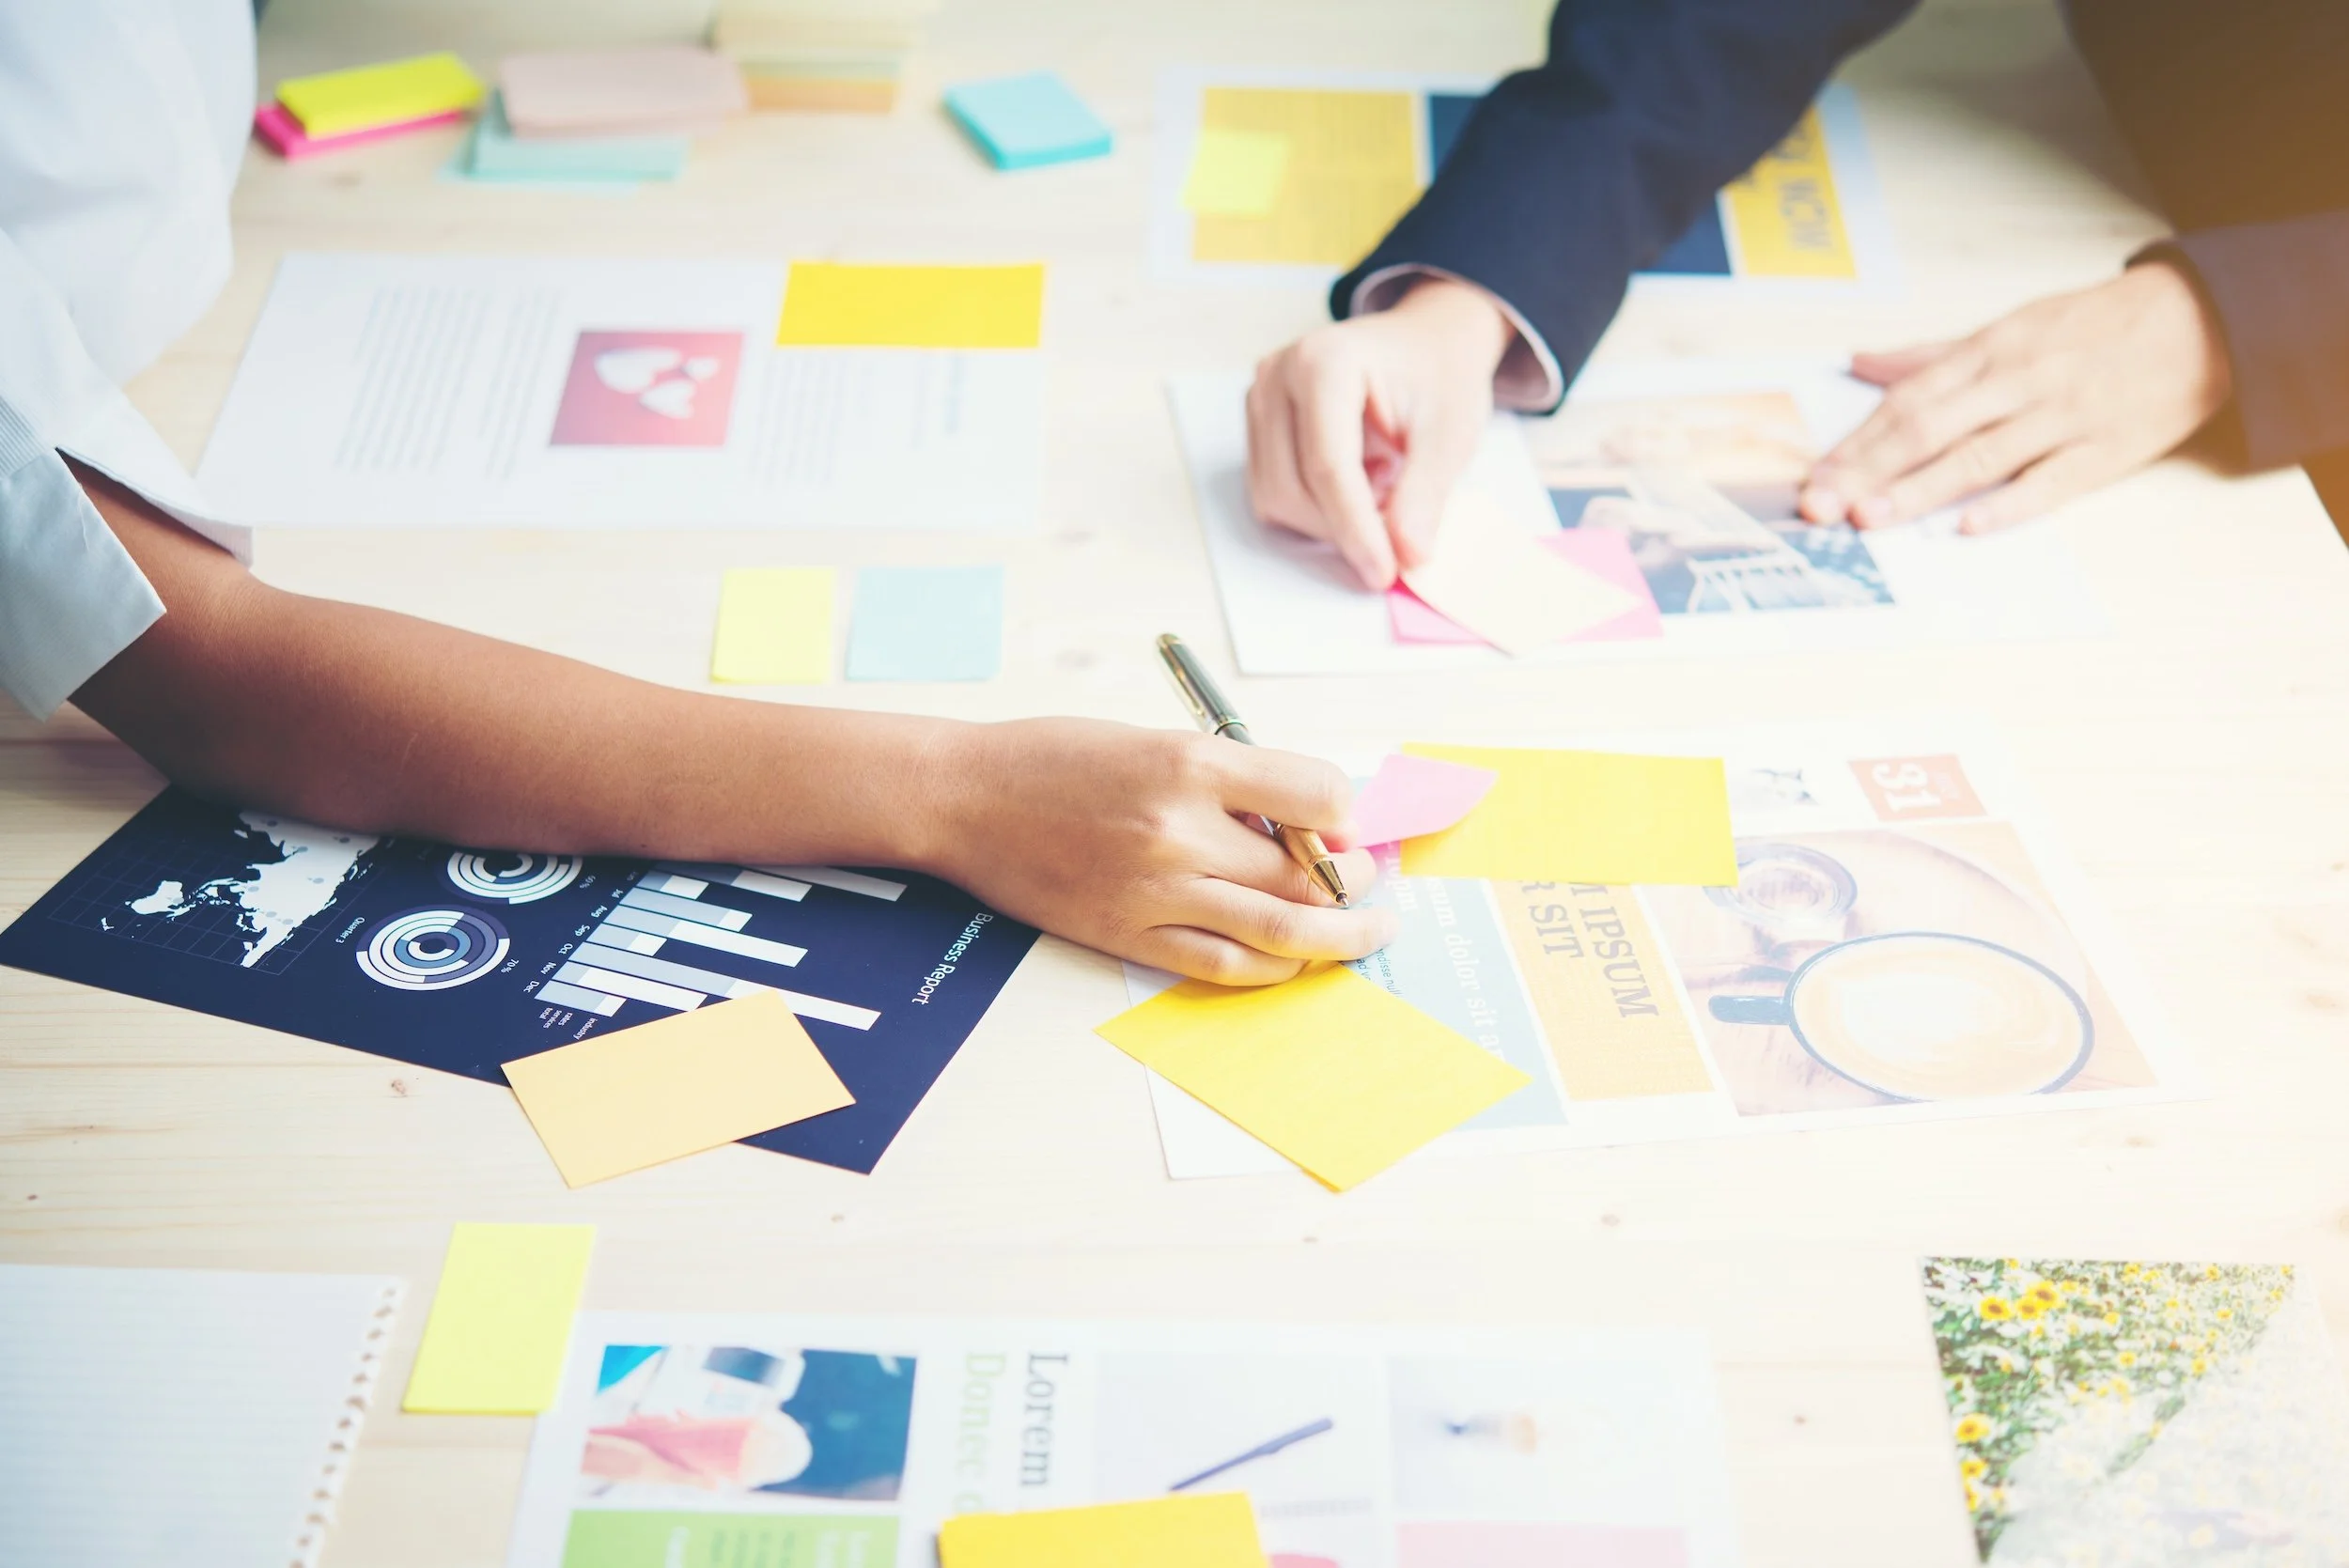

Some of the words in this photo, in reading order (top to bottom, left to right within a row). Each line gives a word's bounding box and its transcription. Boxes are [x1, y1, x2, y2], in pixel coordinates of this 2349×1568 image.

[1872, 763, 1941, 814] 31
[611, 889, 624, 899] Jul
[591, 905, 608, 918] Aug
[340, 917, 366, 939] Quarter
[575, 924, 591, 938] Sep
[944, 912, 994, 963] Business
[1528, 904, 1585, 958] SIT
[558, 942, 573, 955] Oct
[1426, 877, 1456, 928] sum
[1445, 934, 1480, 990] dolor
[1467, 998, 1498, 1028] sit
[501, 958, 520, 974] 70%
[540, 961, 557, 975] Nov
[1376, 948, 1392, 978] ndisse
[1579, 906, 1659, 1017] IPSUM
[522, 980, 540, 994] Dec
[911, 963, 957, 1006] Report
[542, 1009, 563, 1030] services
[558, 1012, 573, 1027] rates
[572, 1017, 599, 1041] industry
[955, 1351, 1007, 1480] Donec
[1019, 1351, 1070, 1487] Lorem
